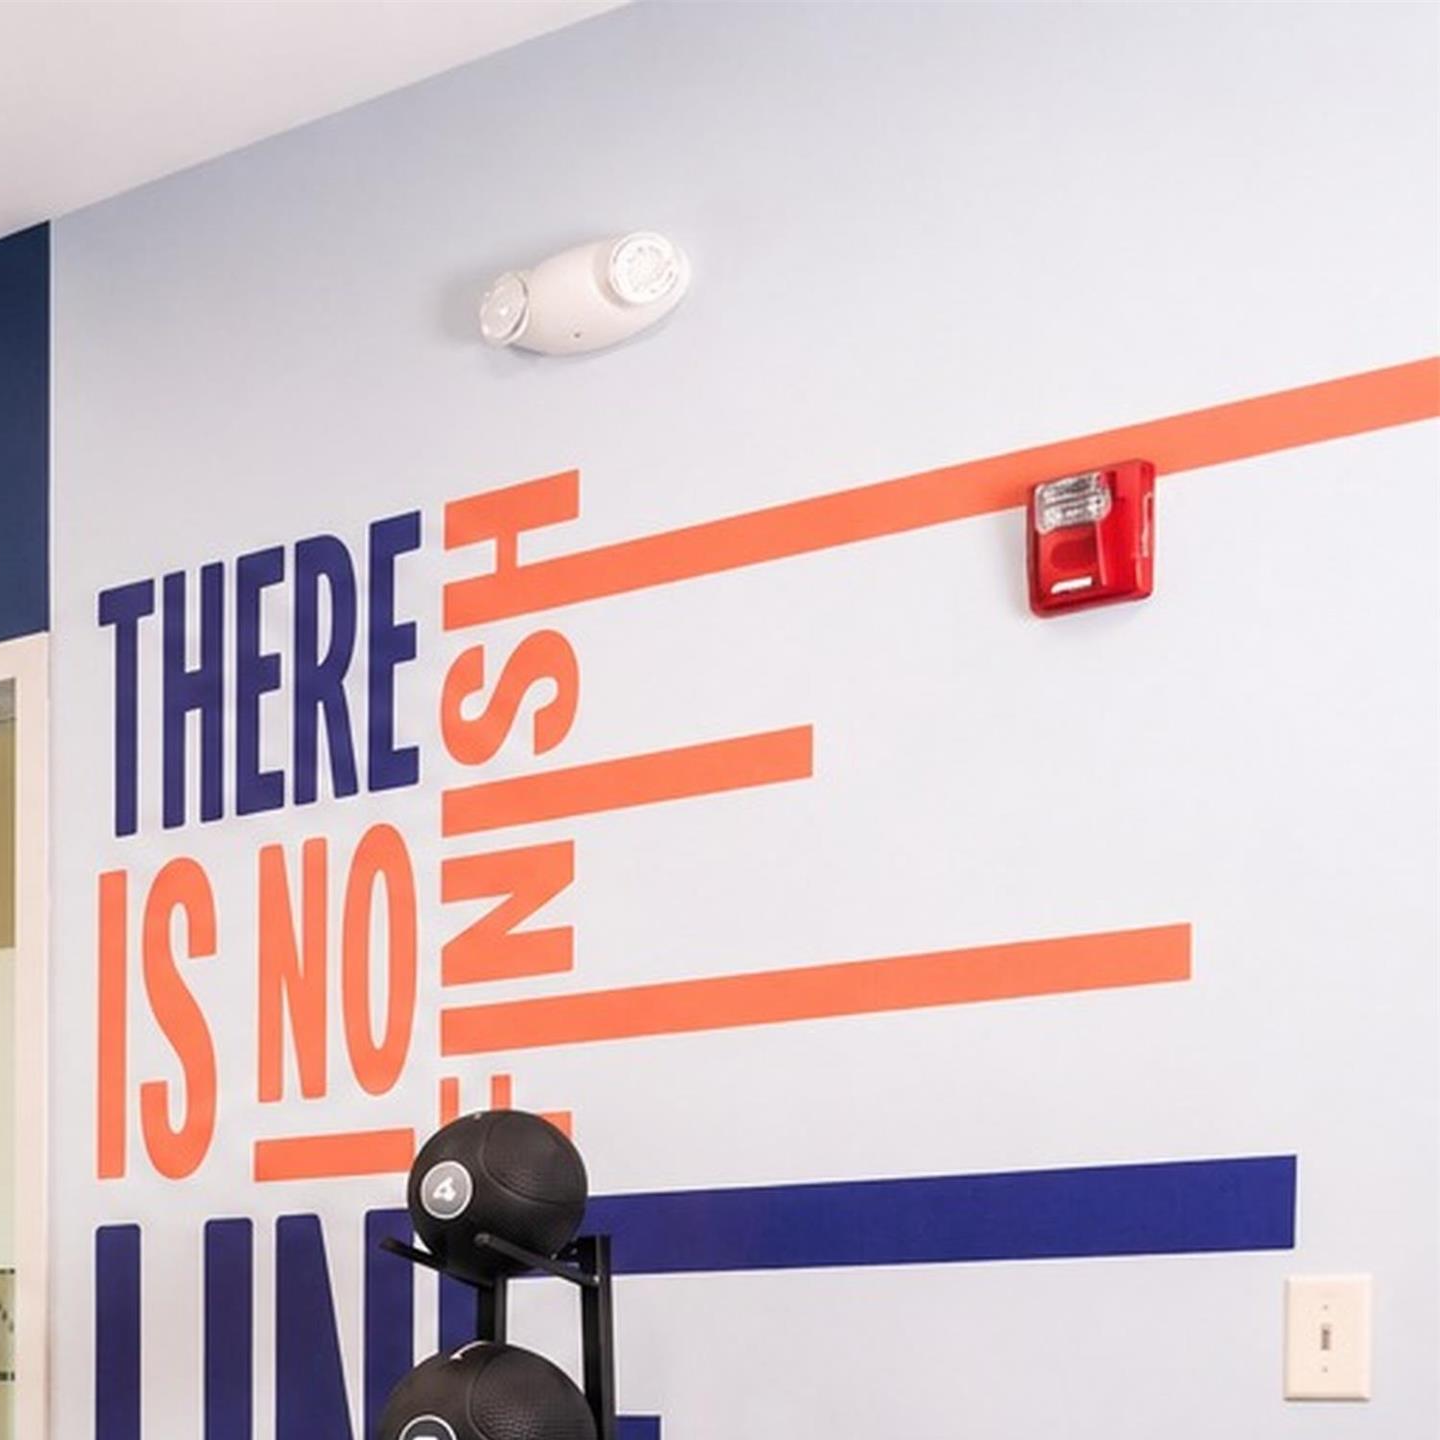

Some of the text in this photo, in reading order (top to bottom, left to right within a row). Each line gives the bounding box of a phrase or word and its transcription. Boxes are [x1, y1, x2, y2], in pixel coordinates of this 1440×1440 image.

[98, 510, 420, 837] THERE
[97, 823, 417, 1180] IS NO
[433, 1177, 456, 1202] 4
